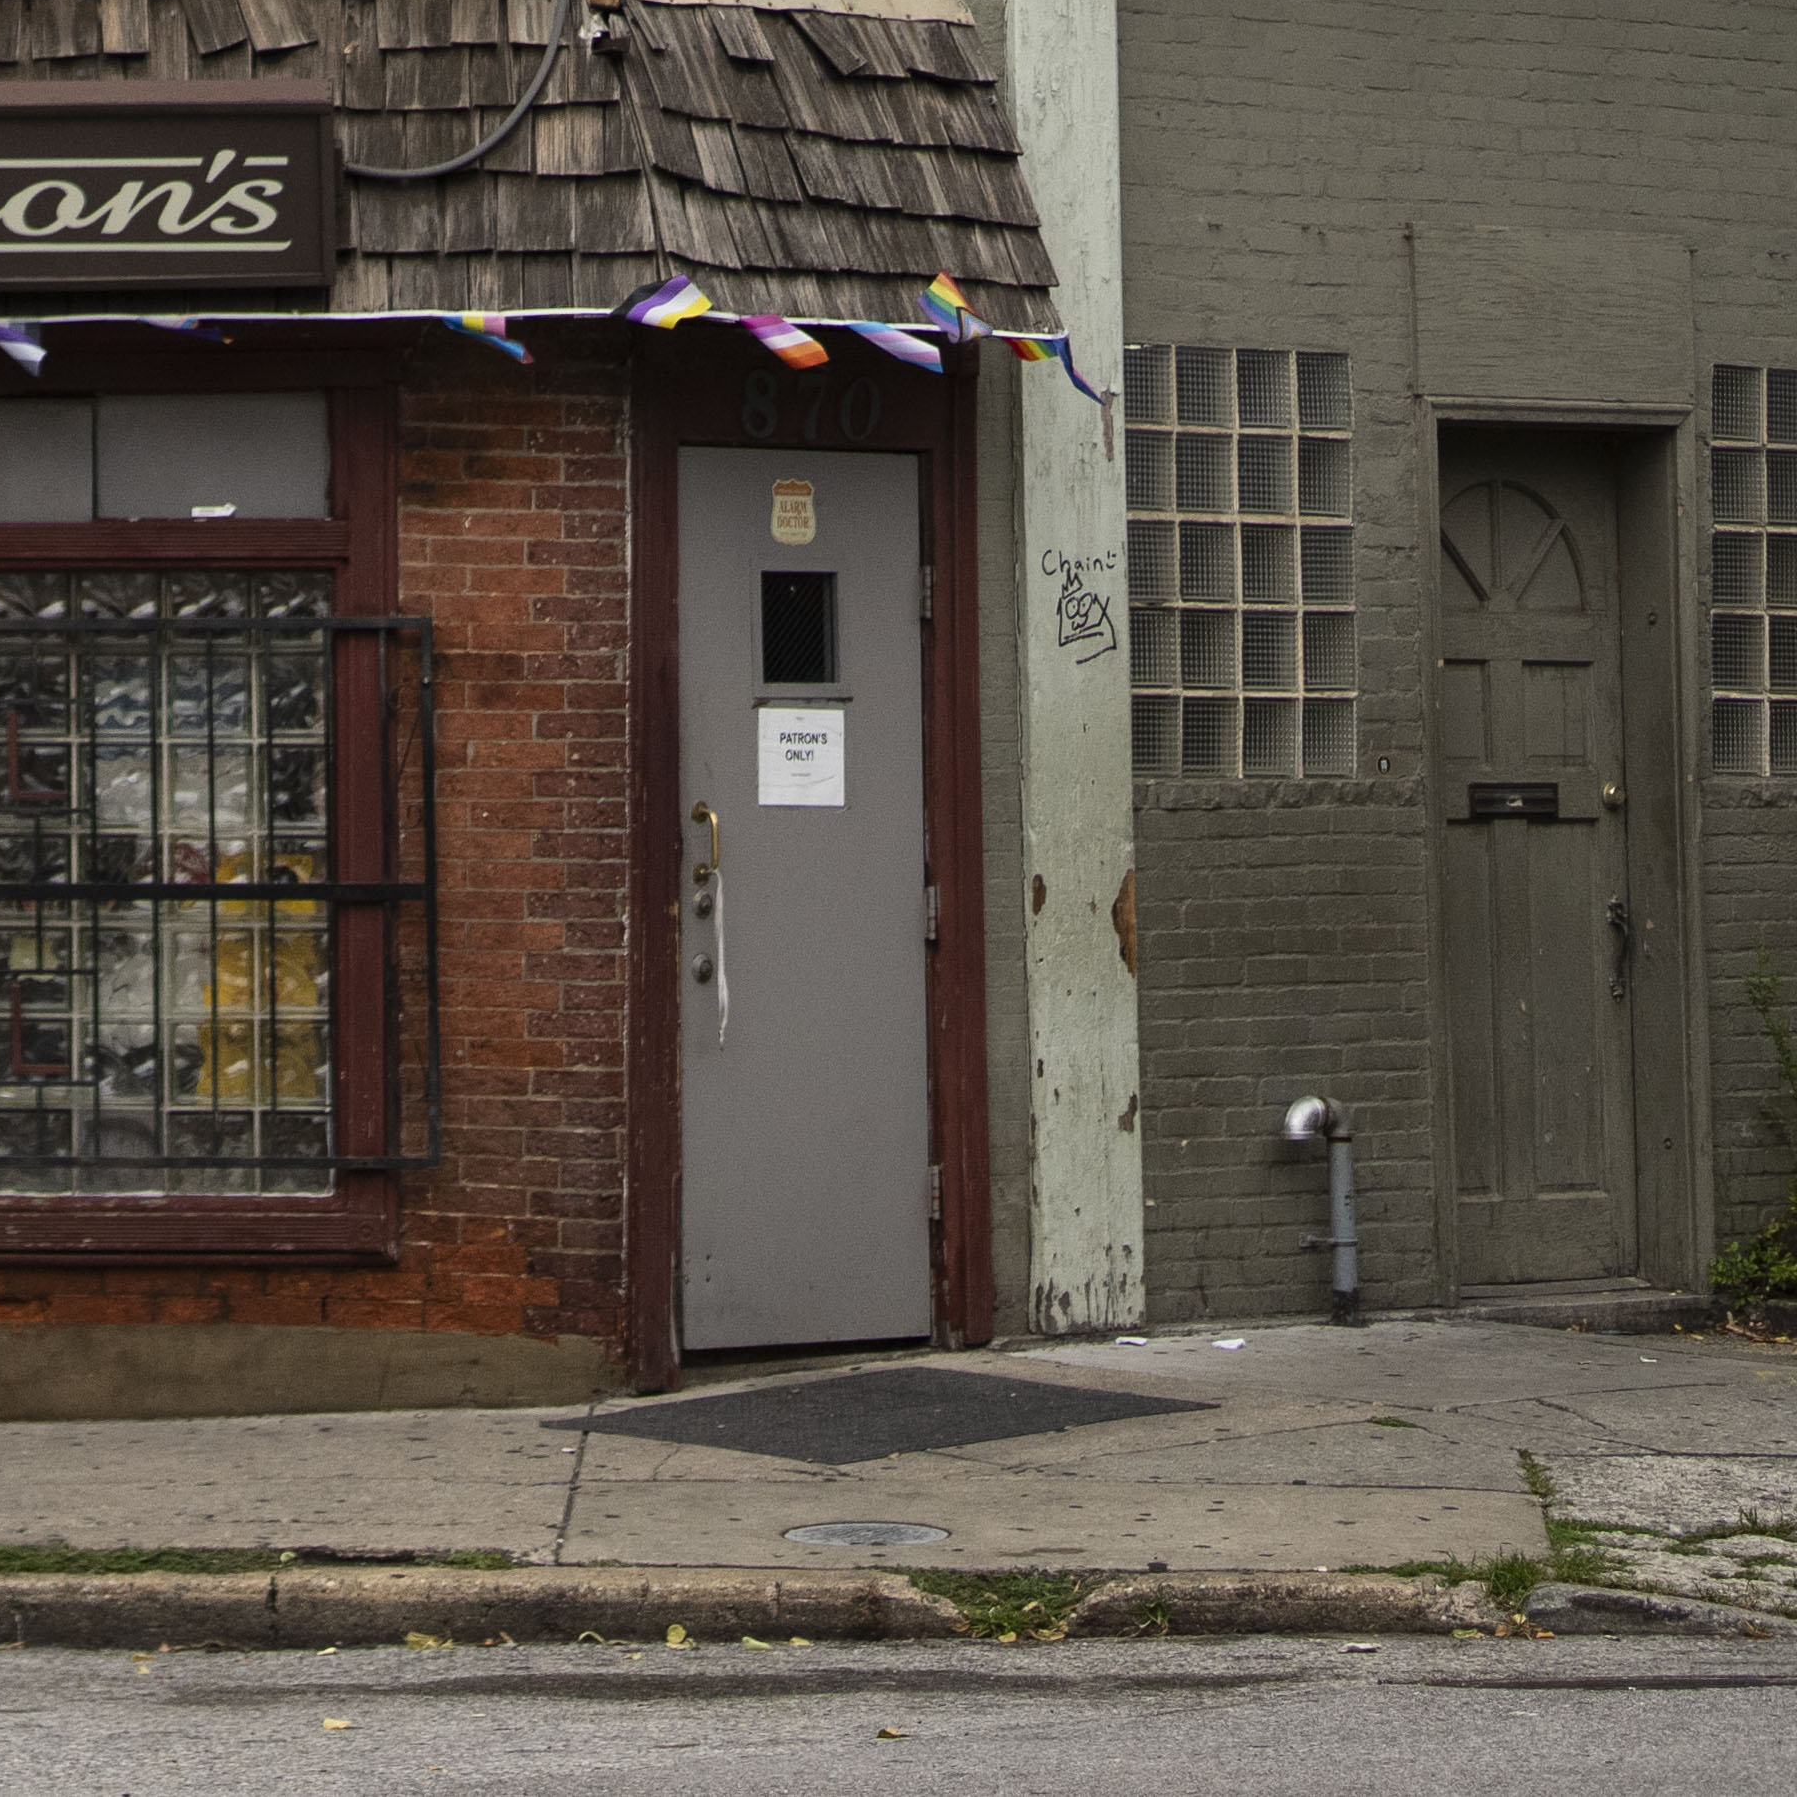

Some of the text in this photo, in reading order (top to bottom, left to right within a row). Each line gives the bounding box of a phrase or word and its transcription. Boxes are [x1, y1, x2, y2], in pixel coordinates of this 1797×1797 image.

[741, 368, 881, 441] 870
[779, 731, 828, 745] PATRON'S
[785, 748, 814, 762] ONLY!
